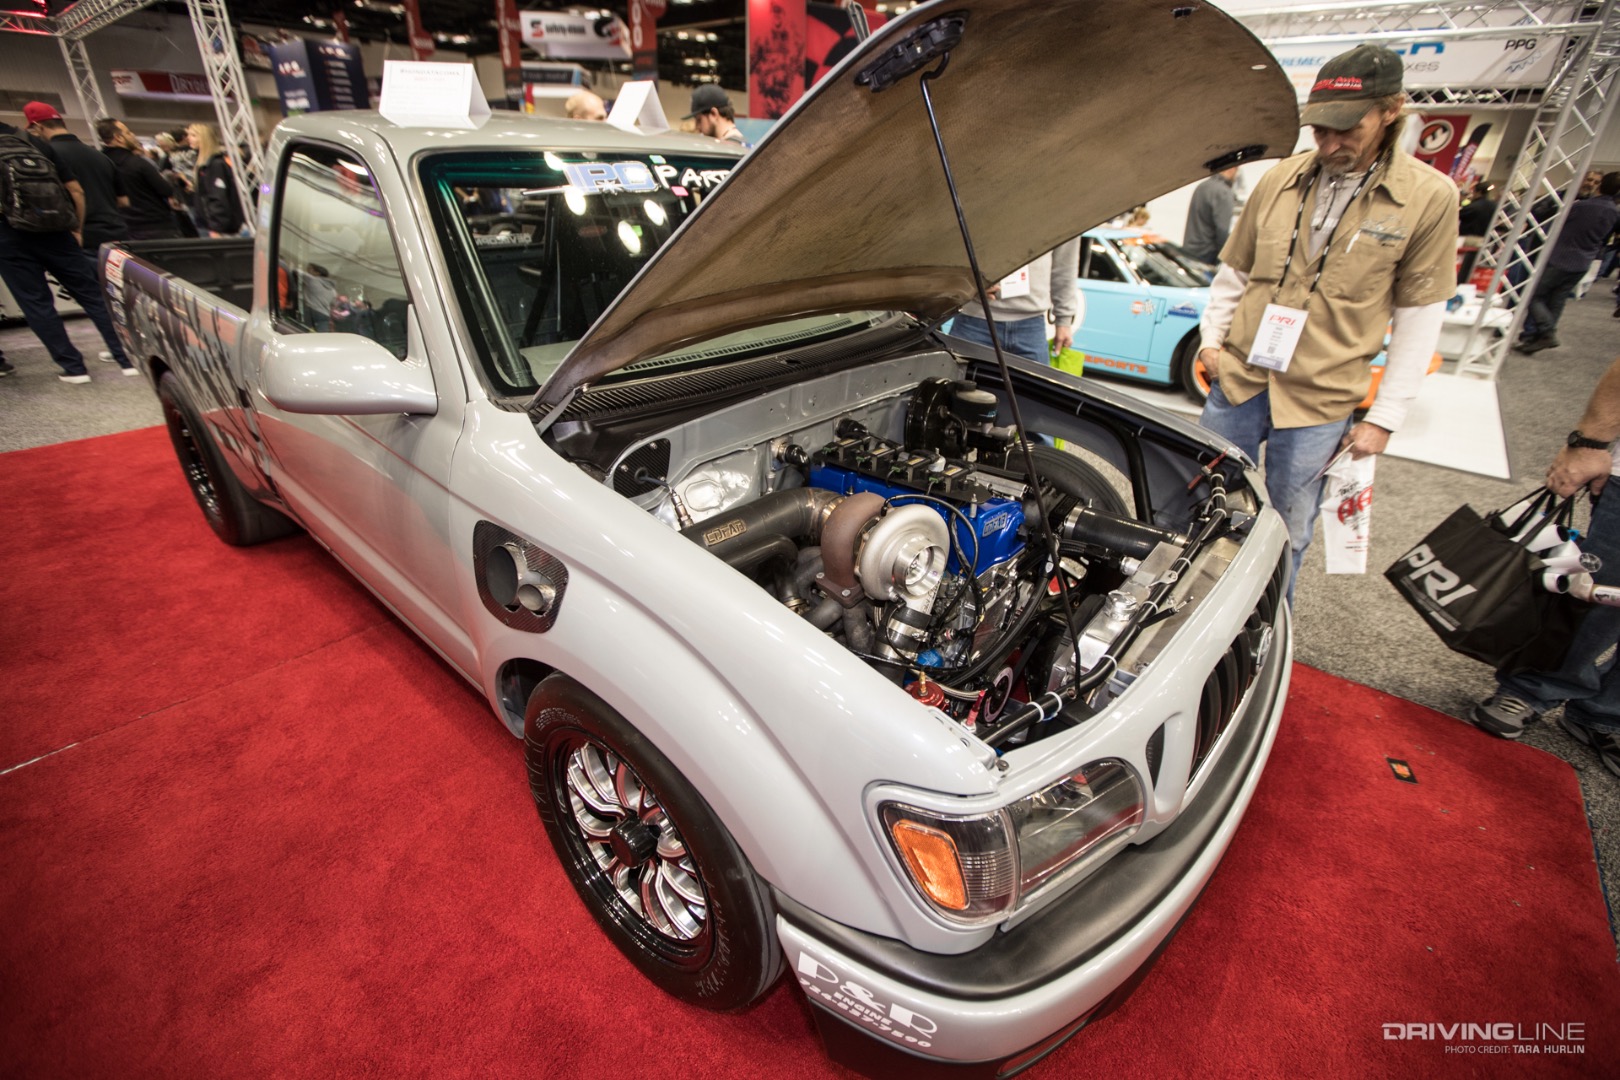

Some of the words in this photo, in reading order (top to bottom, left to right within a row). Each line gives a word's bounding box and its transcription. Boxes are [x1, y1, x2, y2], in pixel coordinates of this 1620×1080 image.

[1504, 38, 1537, 51] PPG
[1269, 314, 1297, 327] PRI
[1085, 353, 1148, 374] SPORTS
[1398, 543, 1478, 607] PRI
[833, 991, 893, 1026] ENGINE
